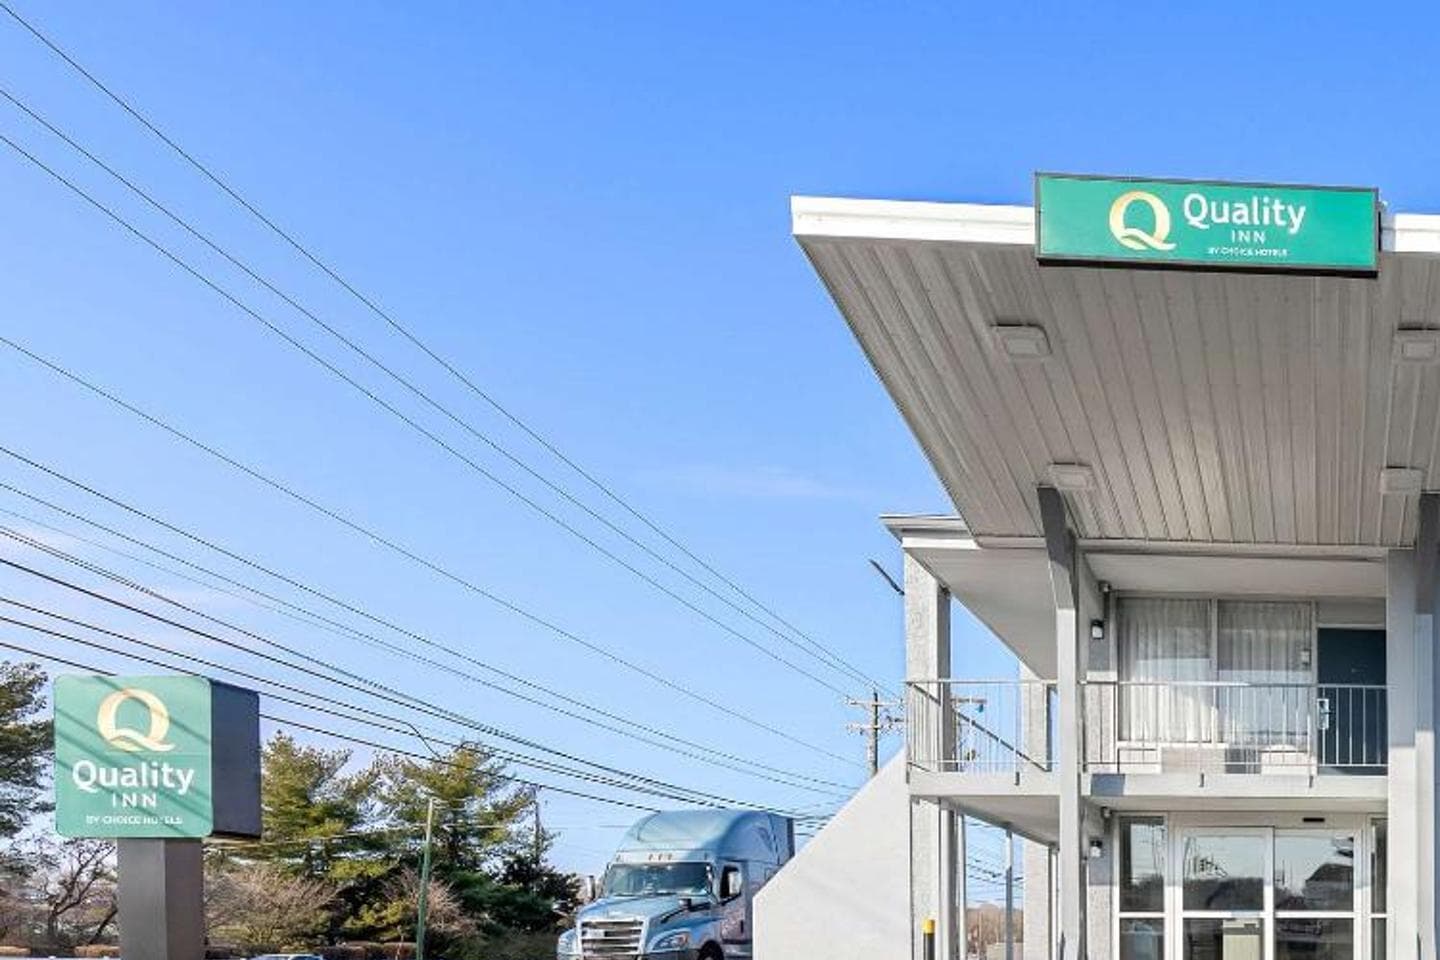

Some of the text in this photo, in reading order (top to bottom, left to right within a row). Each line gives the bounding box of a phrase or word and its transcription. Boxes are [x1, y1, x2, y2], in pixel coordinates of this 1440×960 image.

[1109, 191, 1176, 250] Q
[1184, 194, 1306, 234] Quality
[1231, 229, 1266, 244] INN
[97, 688, 176, 752] Q
[72, 760, 194, 795] Quality
[112, 792, 157, 808] INN
